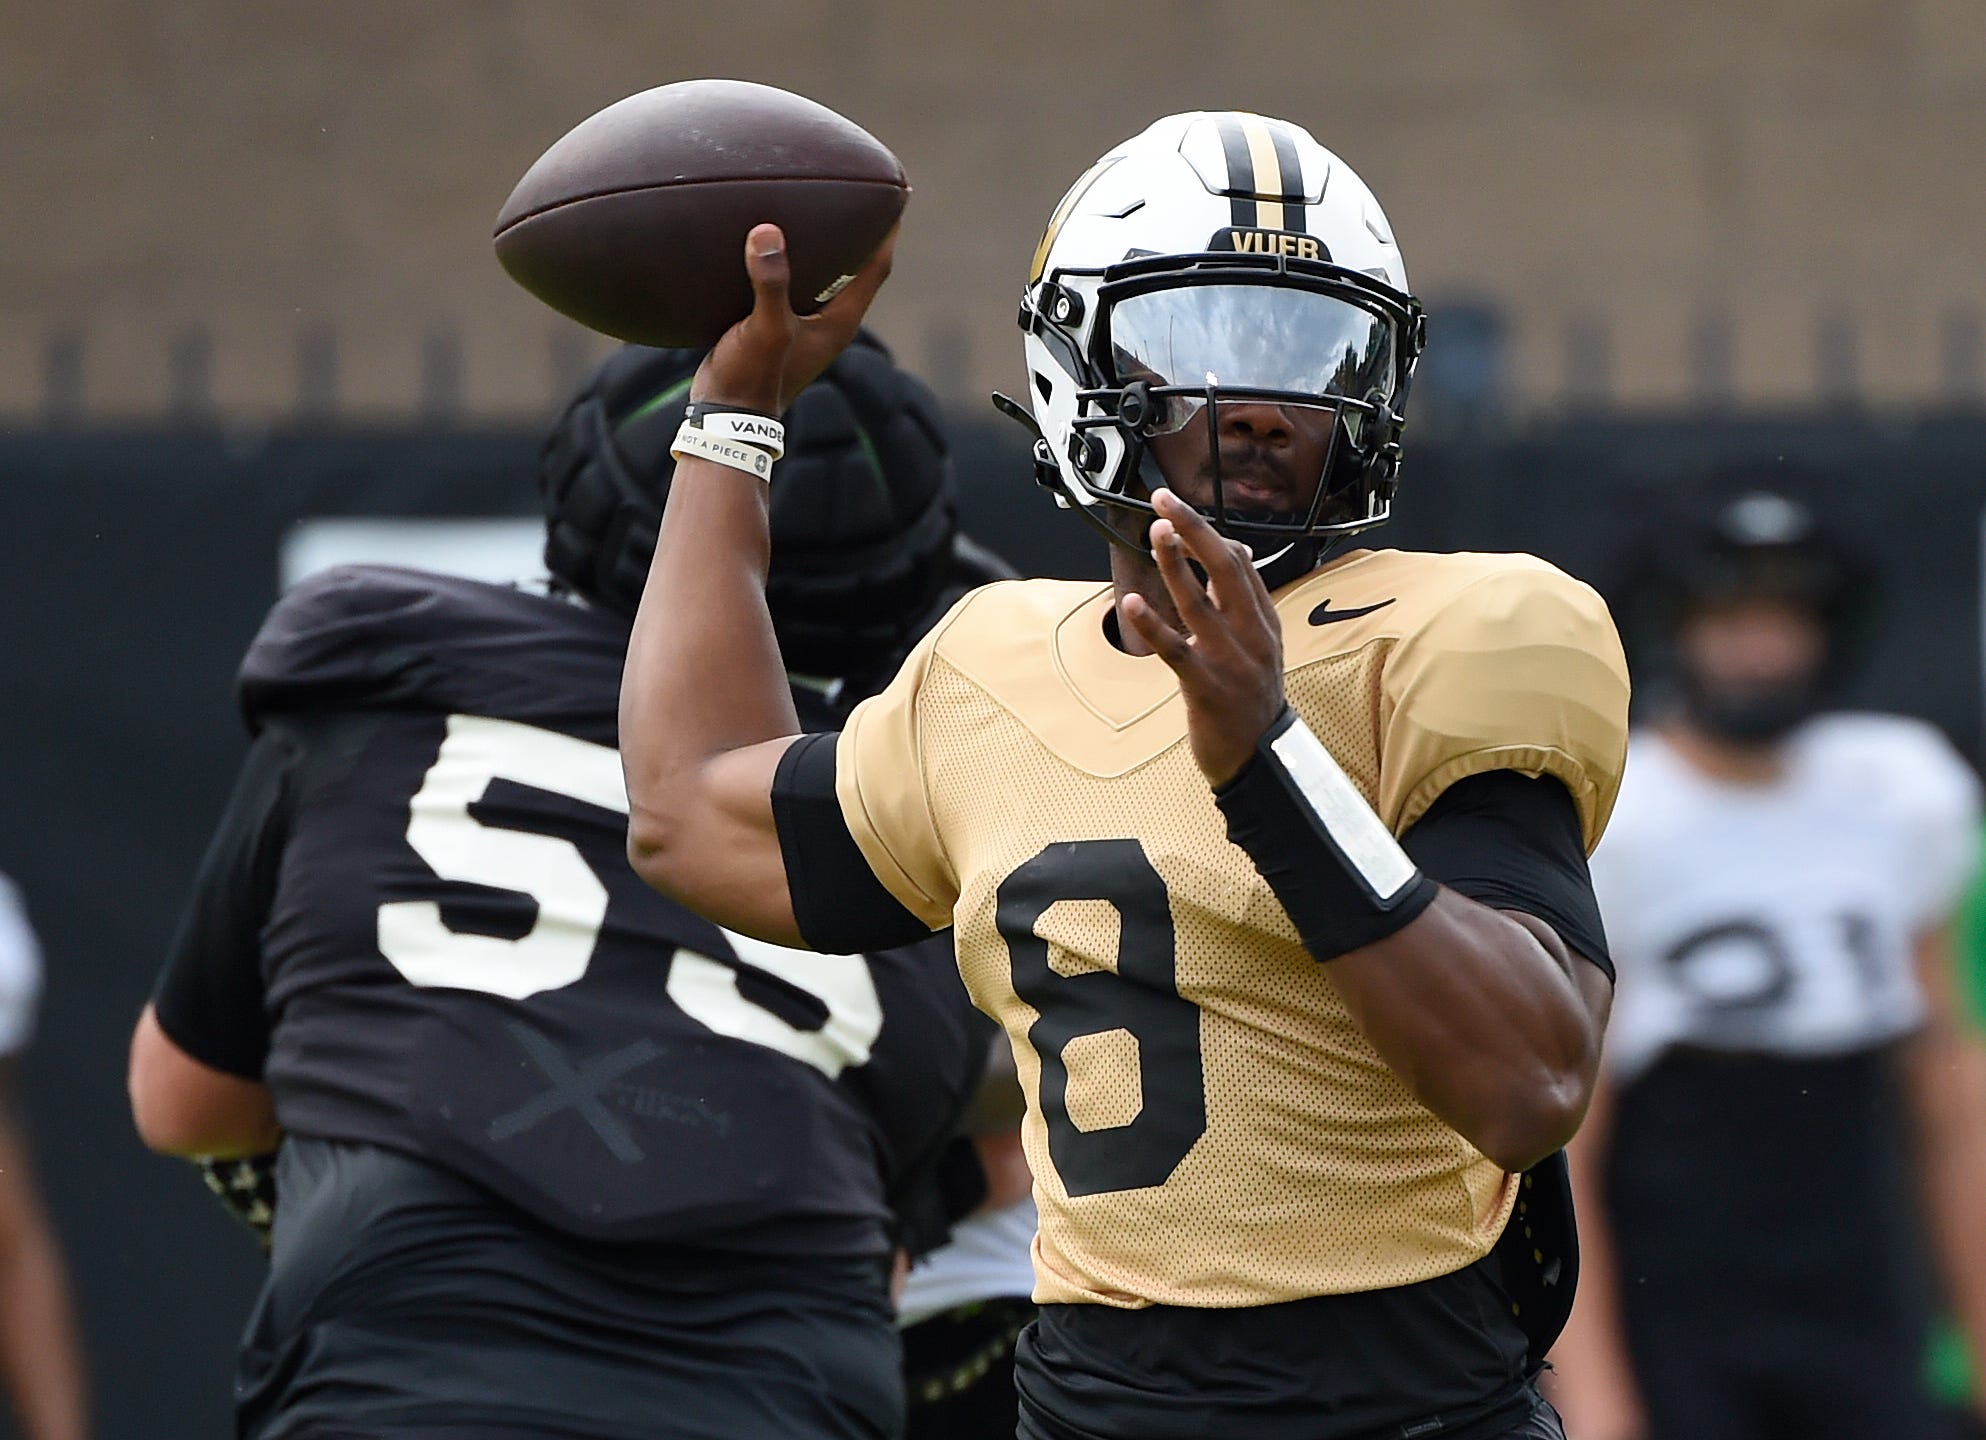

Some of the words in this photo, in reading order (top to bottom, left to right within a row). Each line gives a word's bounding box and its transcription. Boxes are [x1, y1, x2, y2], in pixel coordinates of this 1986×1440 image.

[701, 441, 708, 449] A
[712, 444, 748, 462] PIECE
[995, 838, 1207, 1199] 8
